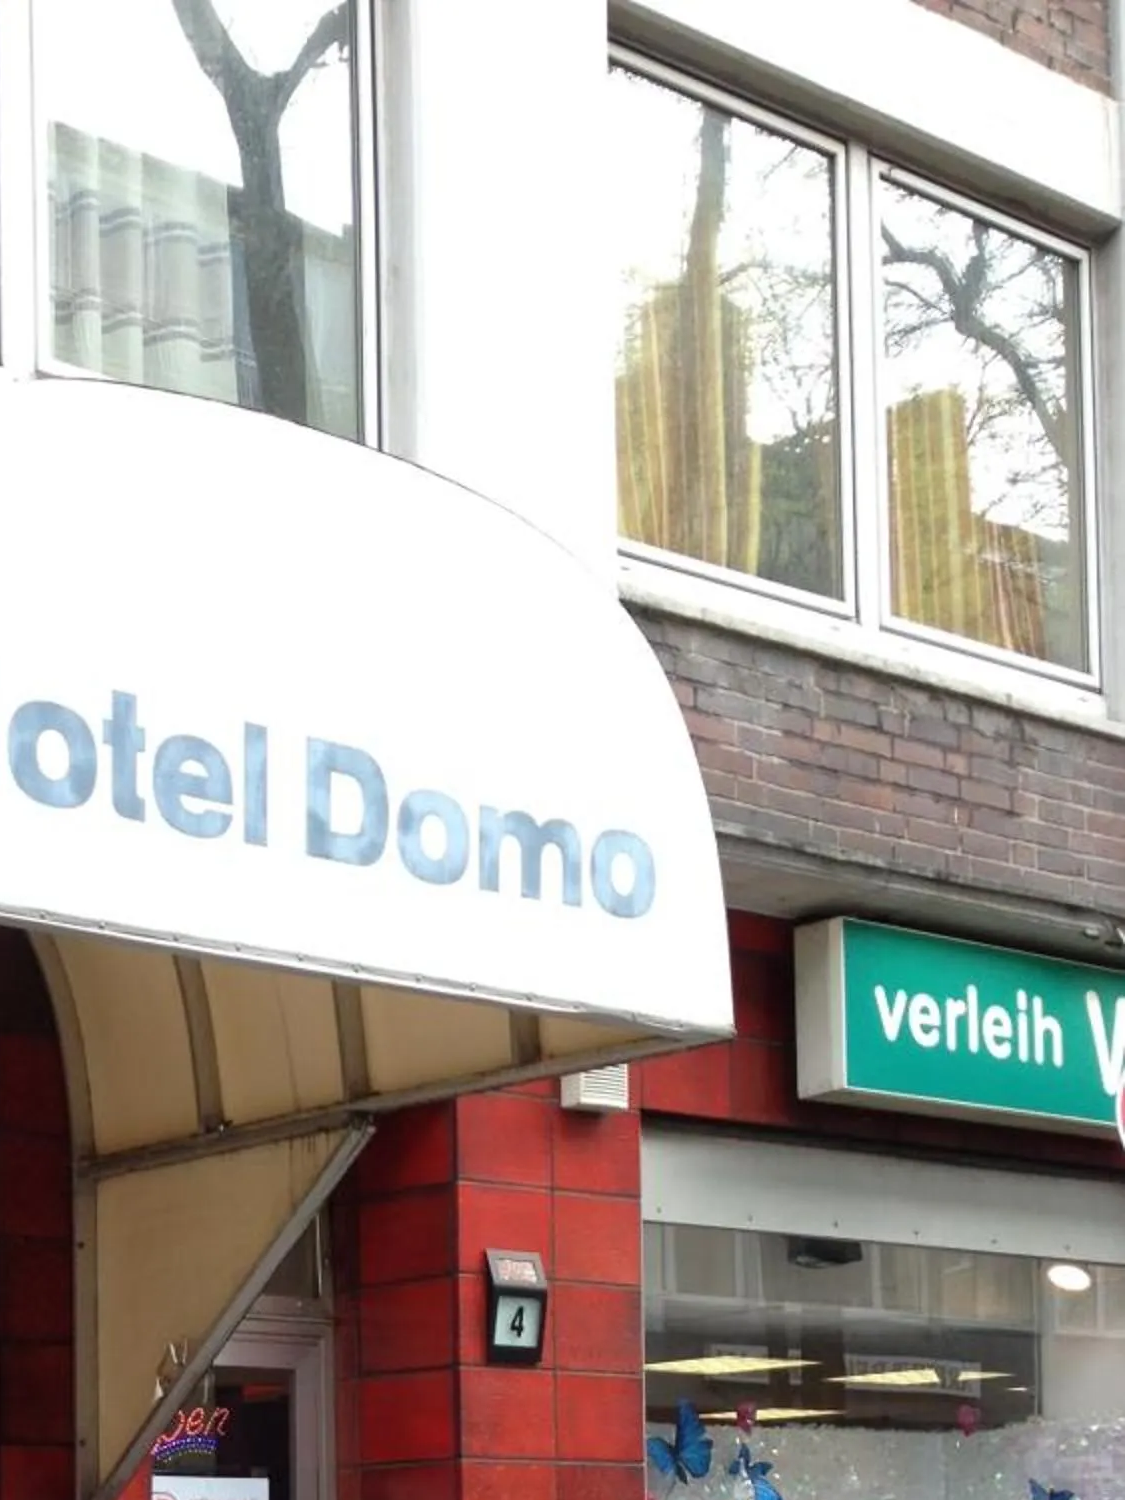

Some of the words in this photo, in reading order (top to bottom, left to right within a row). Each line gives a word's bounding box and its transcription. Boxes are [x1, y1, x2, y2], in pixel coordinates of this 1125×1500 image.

[305, 736, 657, 919] Domo
[874, 984, 1064, 1068] verleih
[510, 1305, 525, 1338] 4
